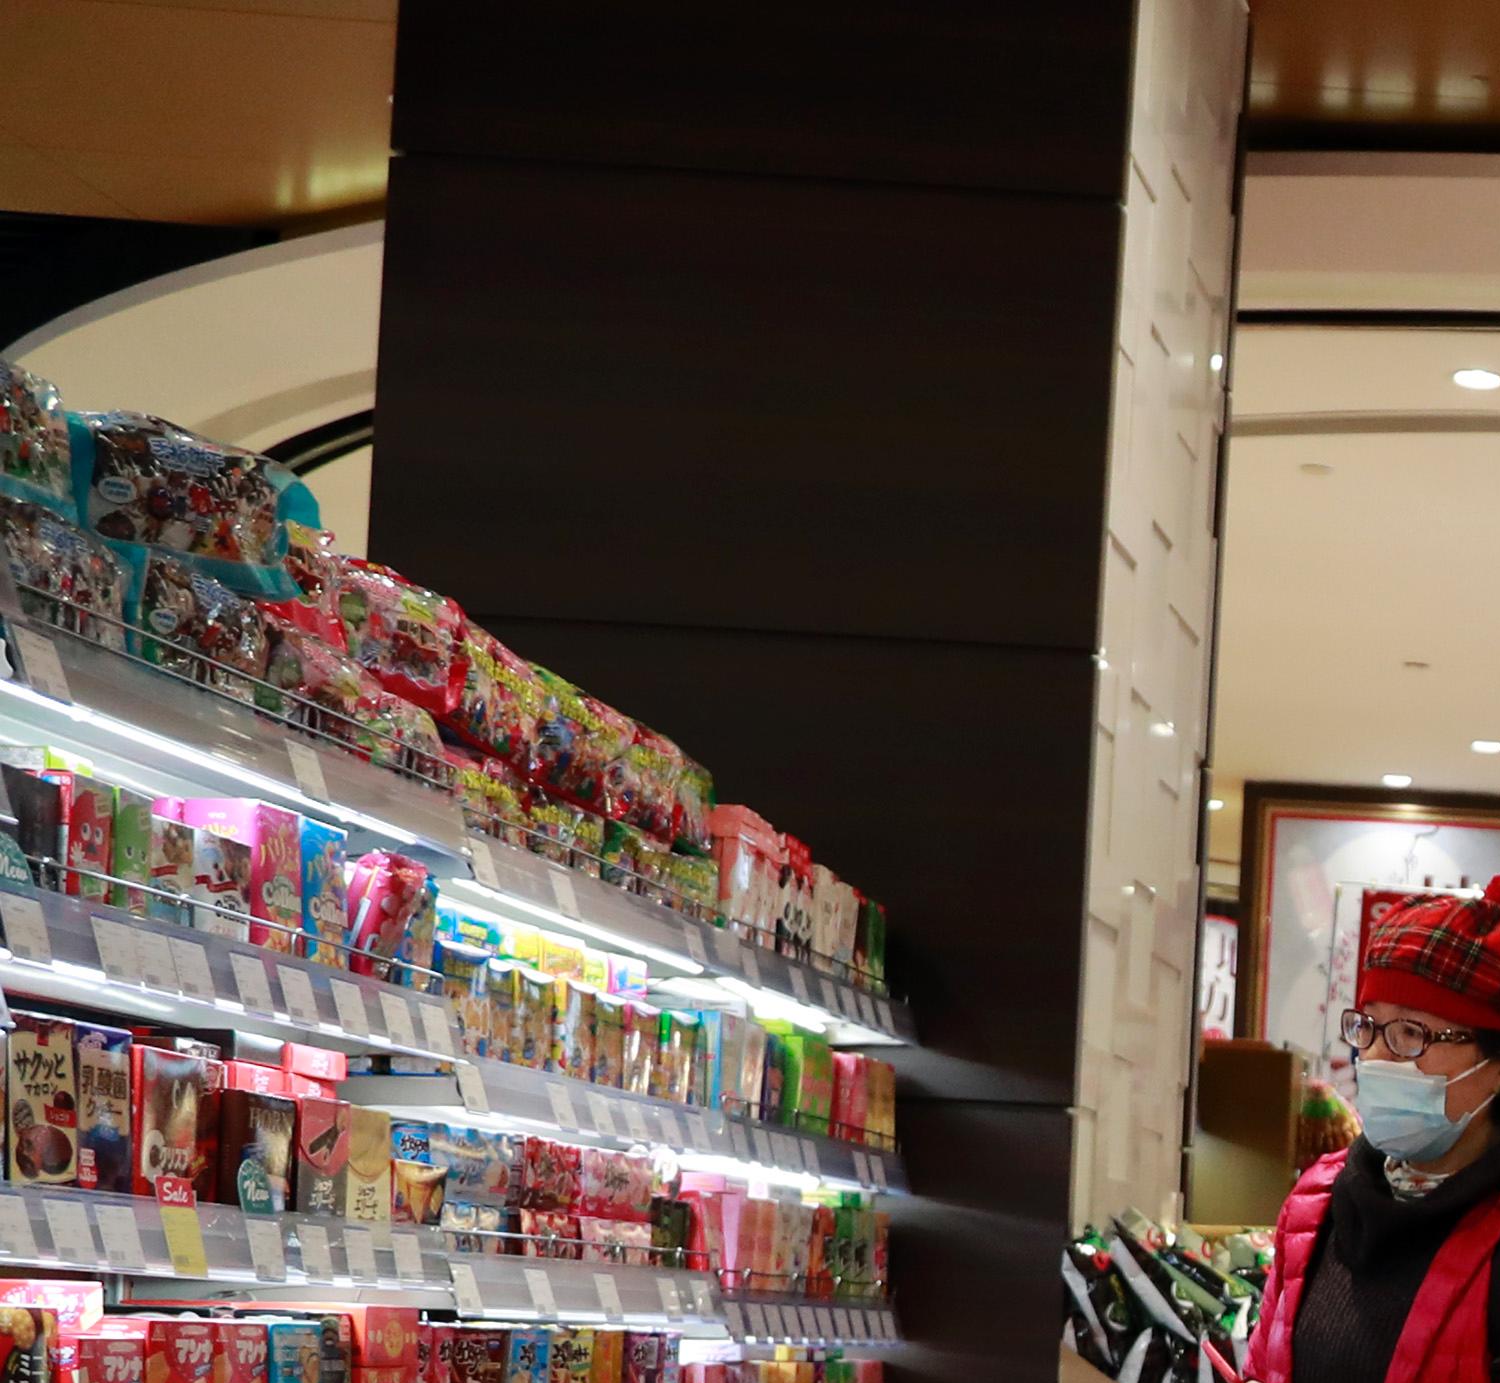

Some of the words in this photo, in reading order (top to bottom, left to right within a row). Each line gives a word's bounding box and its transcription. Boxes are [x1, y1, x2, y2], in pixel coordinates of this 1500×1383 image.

[13, 1049, 67, 1081] サクッと
[24, 1082, 59, 1097] マカロン
[162, 1180, 189, 1204] Sale
[243, 1179, 270, 1203] New
[175, 1338, 214, 1364] マンナ
[103, 1355, 144, 1383] マンナ
